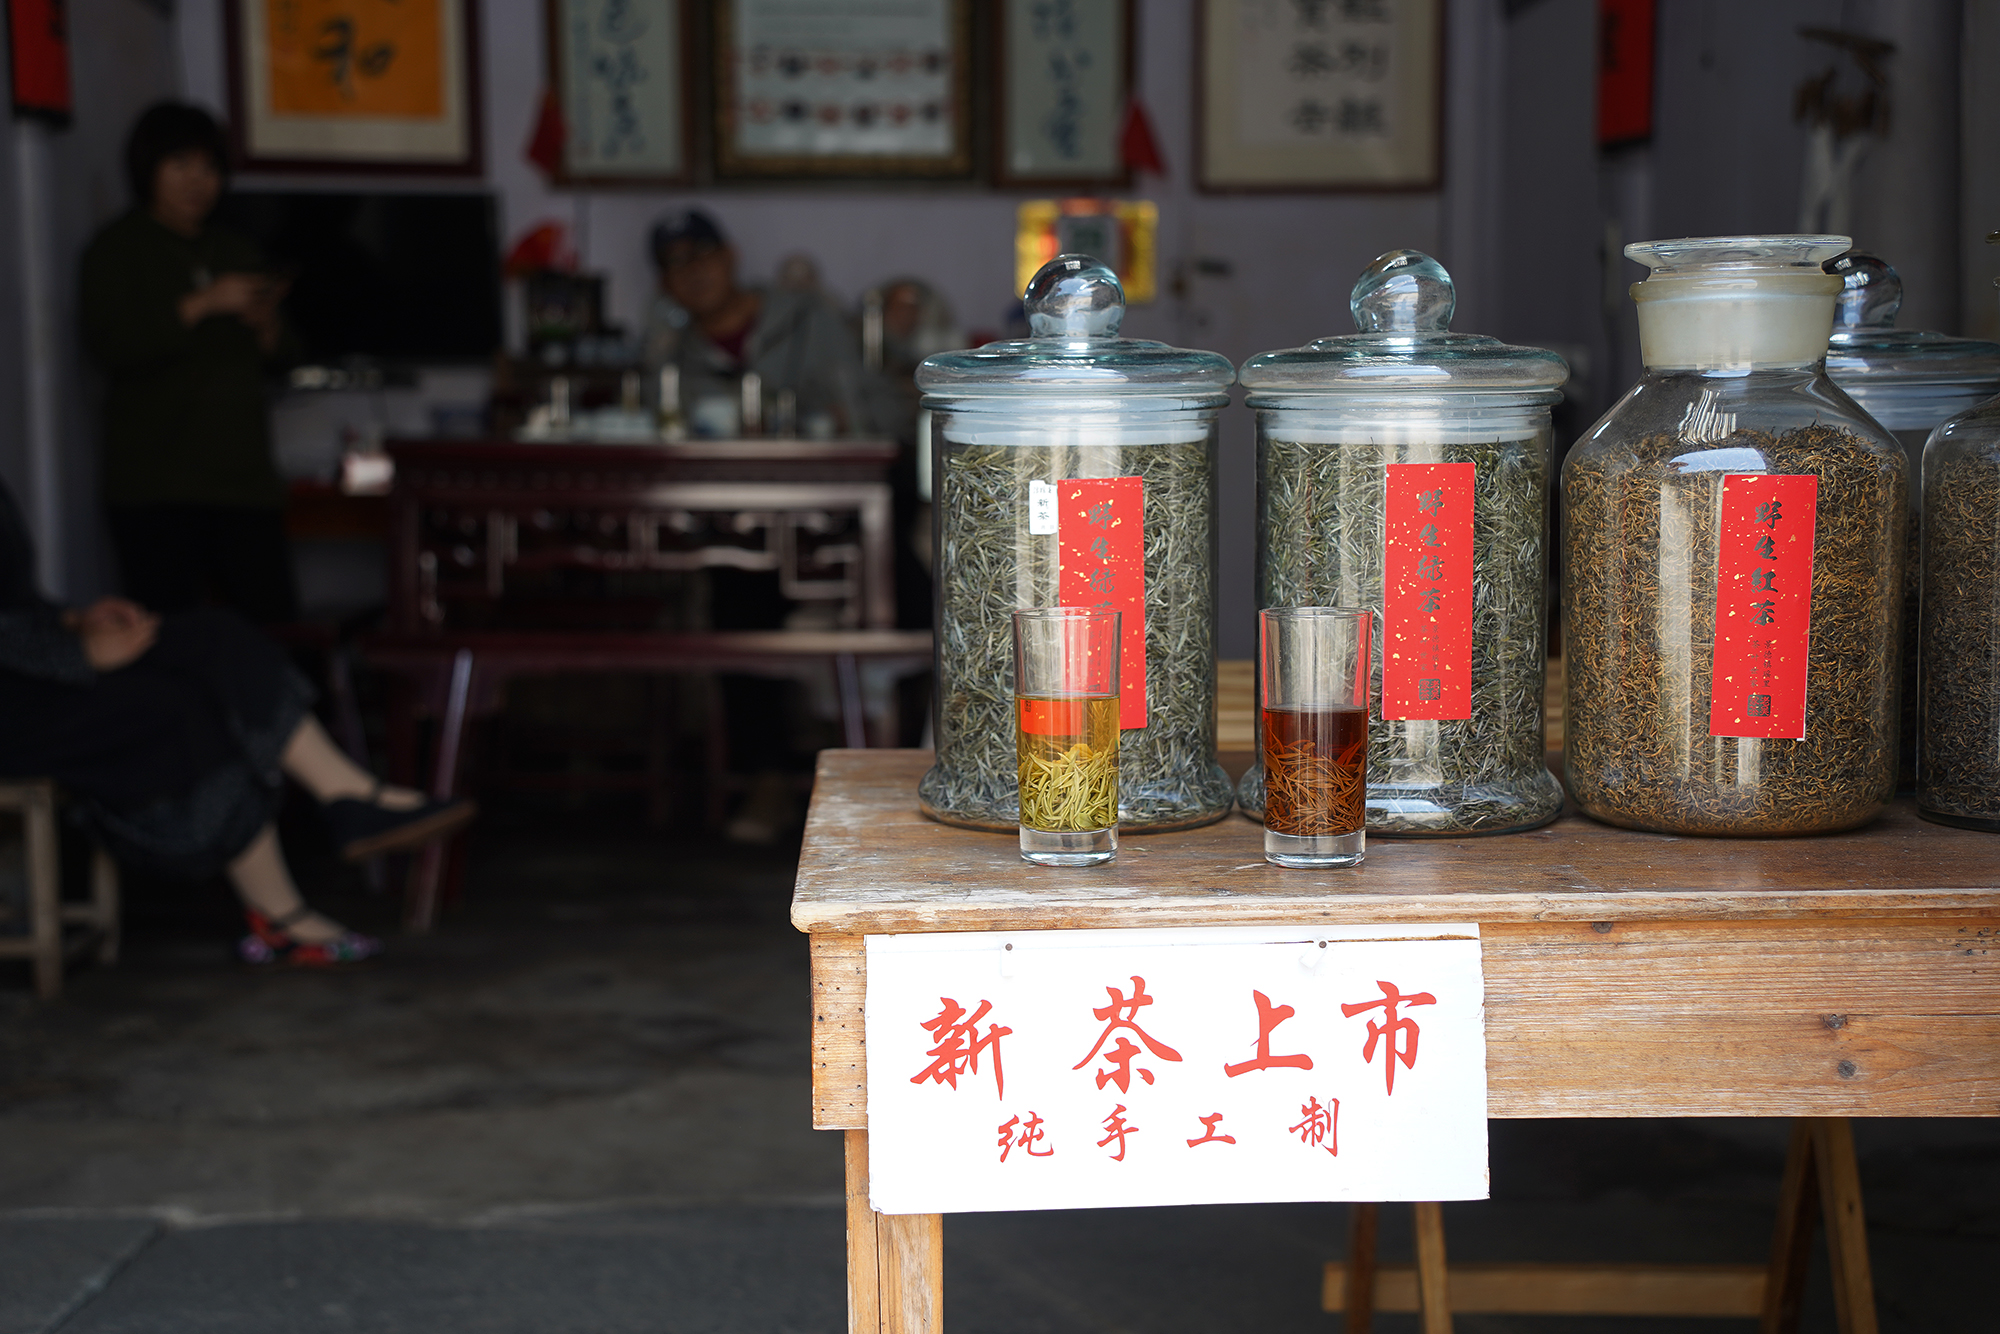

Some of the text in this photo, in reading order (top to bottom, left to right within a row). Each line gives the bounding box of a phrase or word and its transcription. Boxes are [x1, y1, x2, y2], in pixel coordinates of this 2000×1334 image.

[1417, 489, 1444, 613] 野生绿茶
[910, 975, 1437, 1100] 新茶上市
[997, 1095, 1340, 1163] 纯手工制
